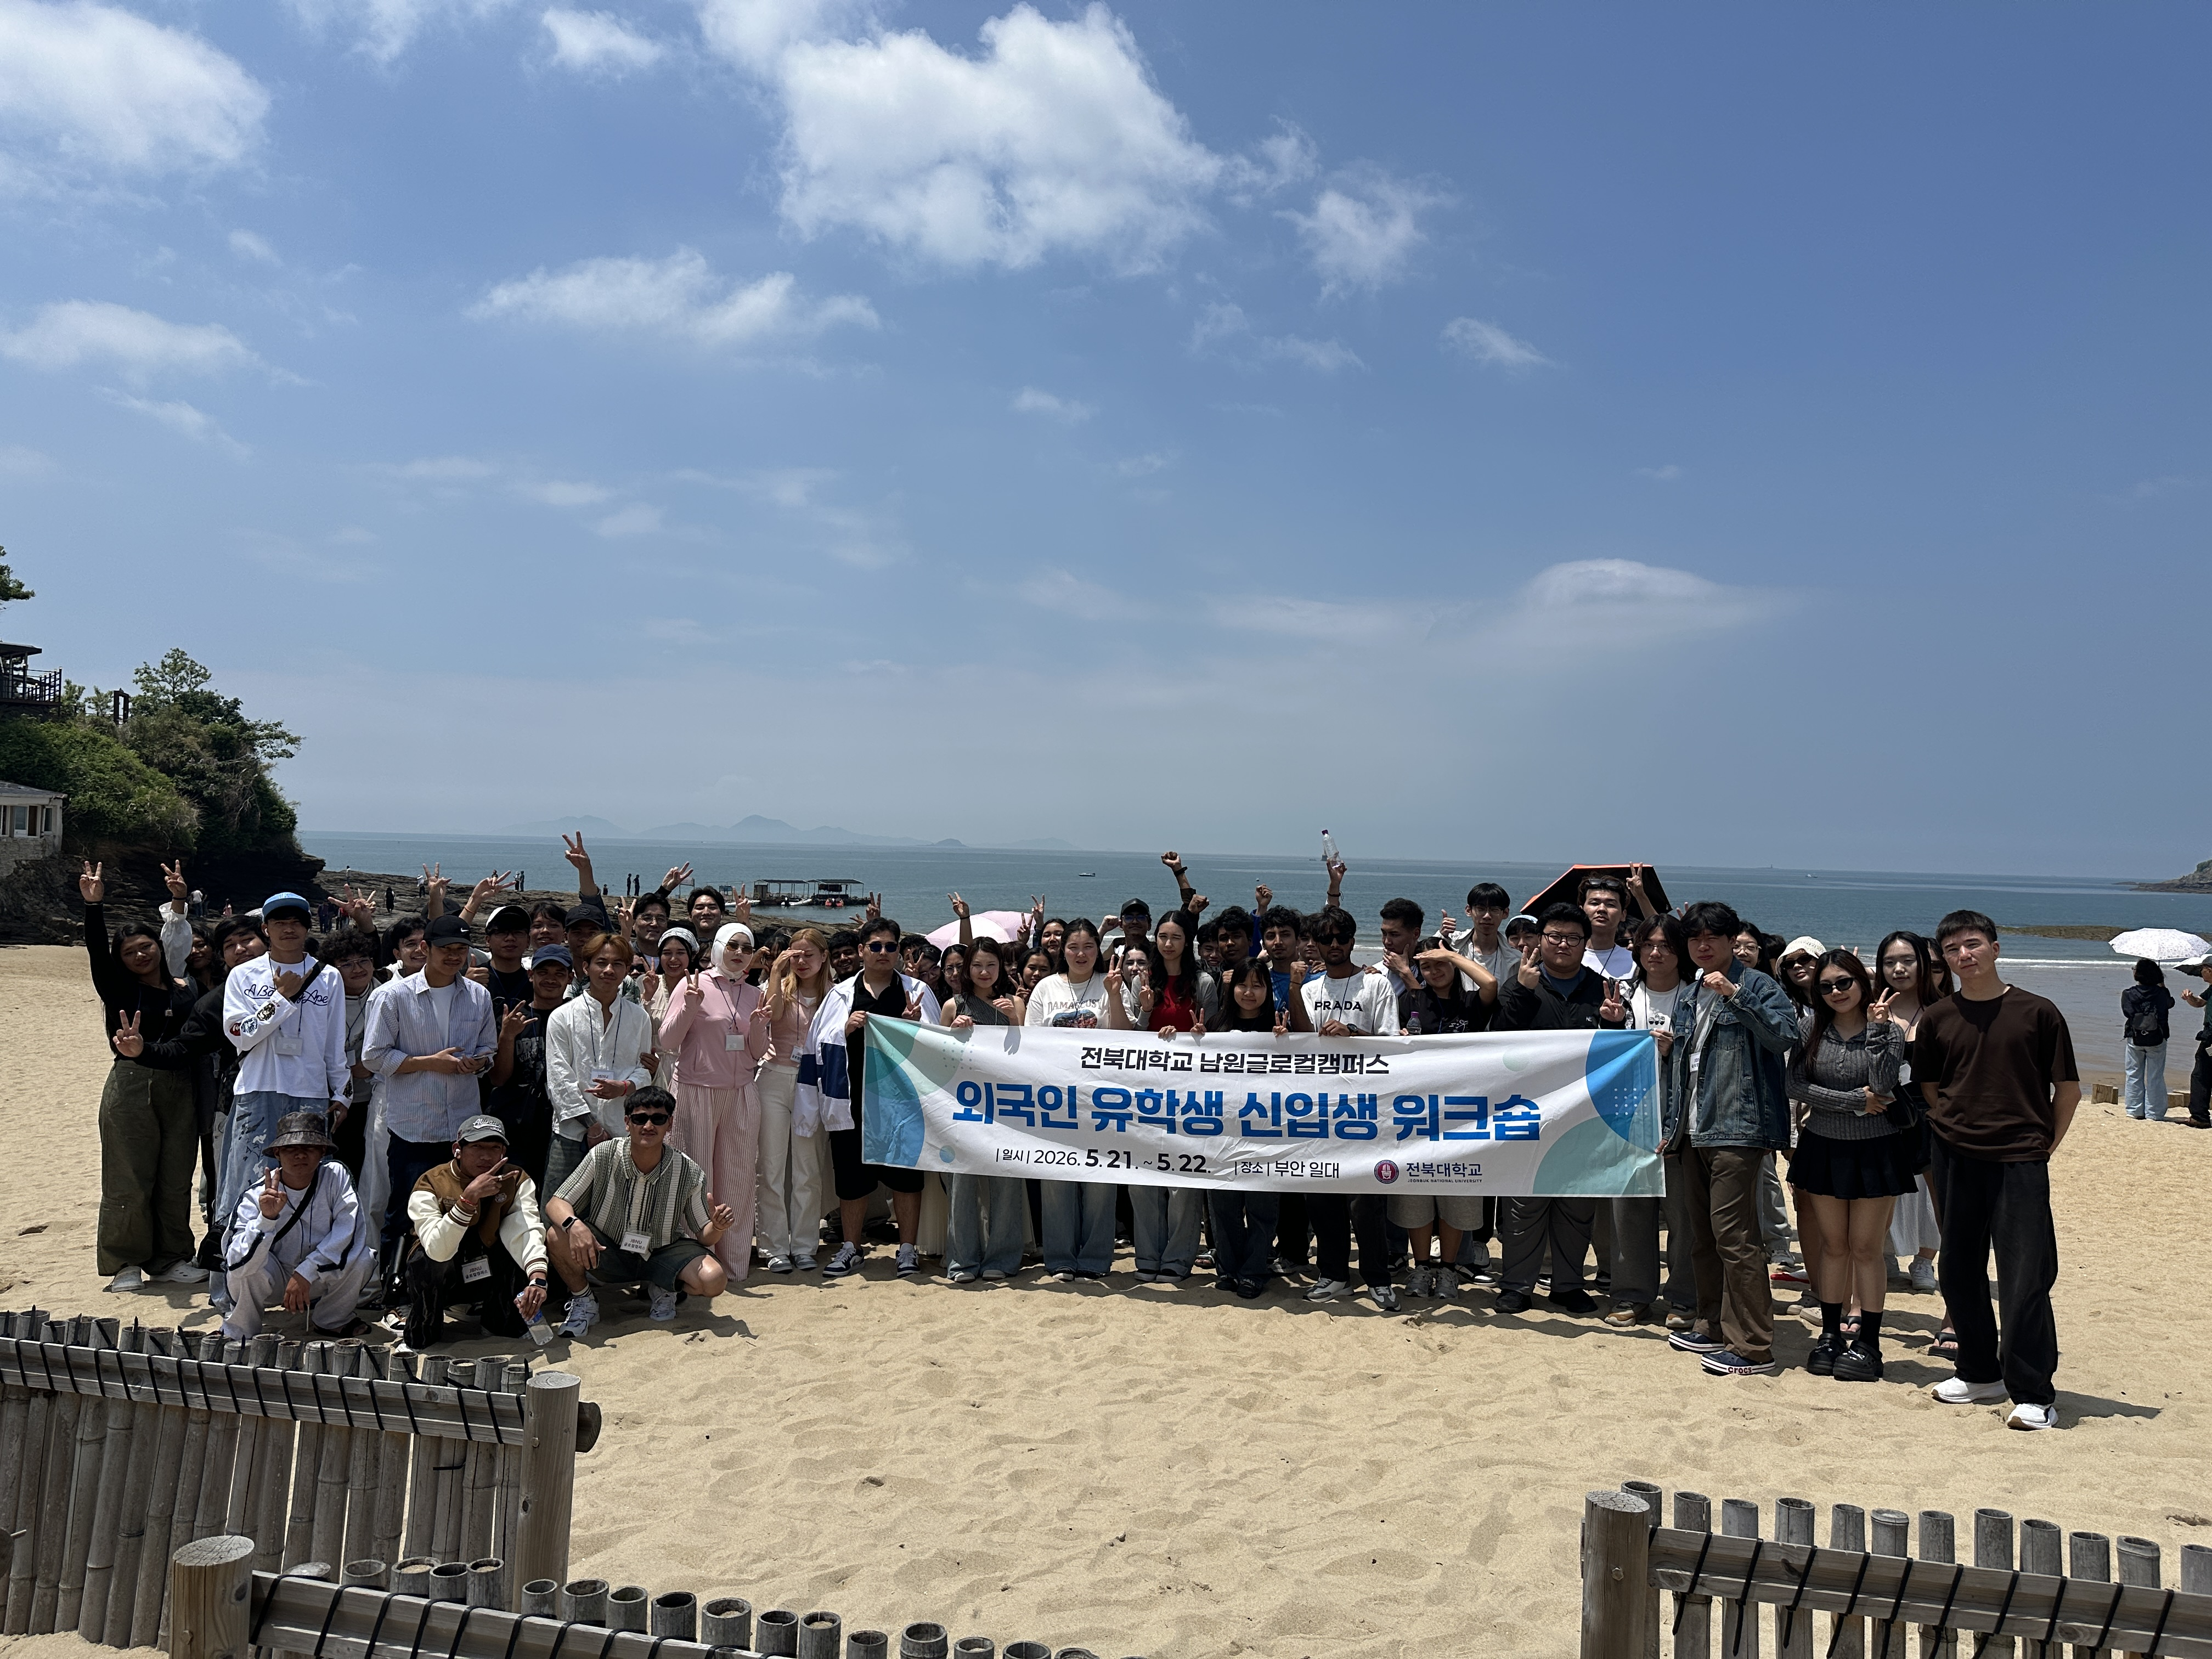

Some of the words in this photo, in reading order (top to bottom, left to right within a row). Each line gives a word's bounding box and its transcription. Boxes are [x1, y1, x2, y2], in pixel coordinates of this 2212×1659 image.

[1314, 1000, 1363, 1012] PRADA
[1080, 1047, 1193, 1071] 전북대학교
[1200, 1053, 1390, 1074] 남원글로컬캠퍼스
[952, 1080, 1079, 1130] 외국인
[1091, 1087, 1224, 1136] 유학생
[1238, 1092, 1378, 1141] 신입생
[1392, 1094, 1541, 1142] 워크숍
[1034, 1150, 1081, 1166] 2026.
[1085, 1149, 1102, 1167] 5.
[1107, 1150, 1138, 1170] 21.
[1156, 1153, 1175, 1171] 5.
[1179, 1154, 1211, 1173] 22.
[1274, 1161, 1306, 1177] 부안
[1310, 1162, 1339, 1178] 일대
[1406, 1162, 1483, 1177] 전북대학교
